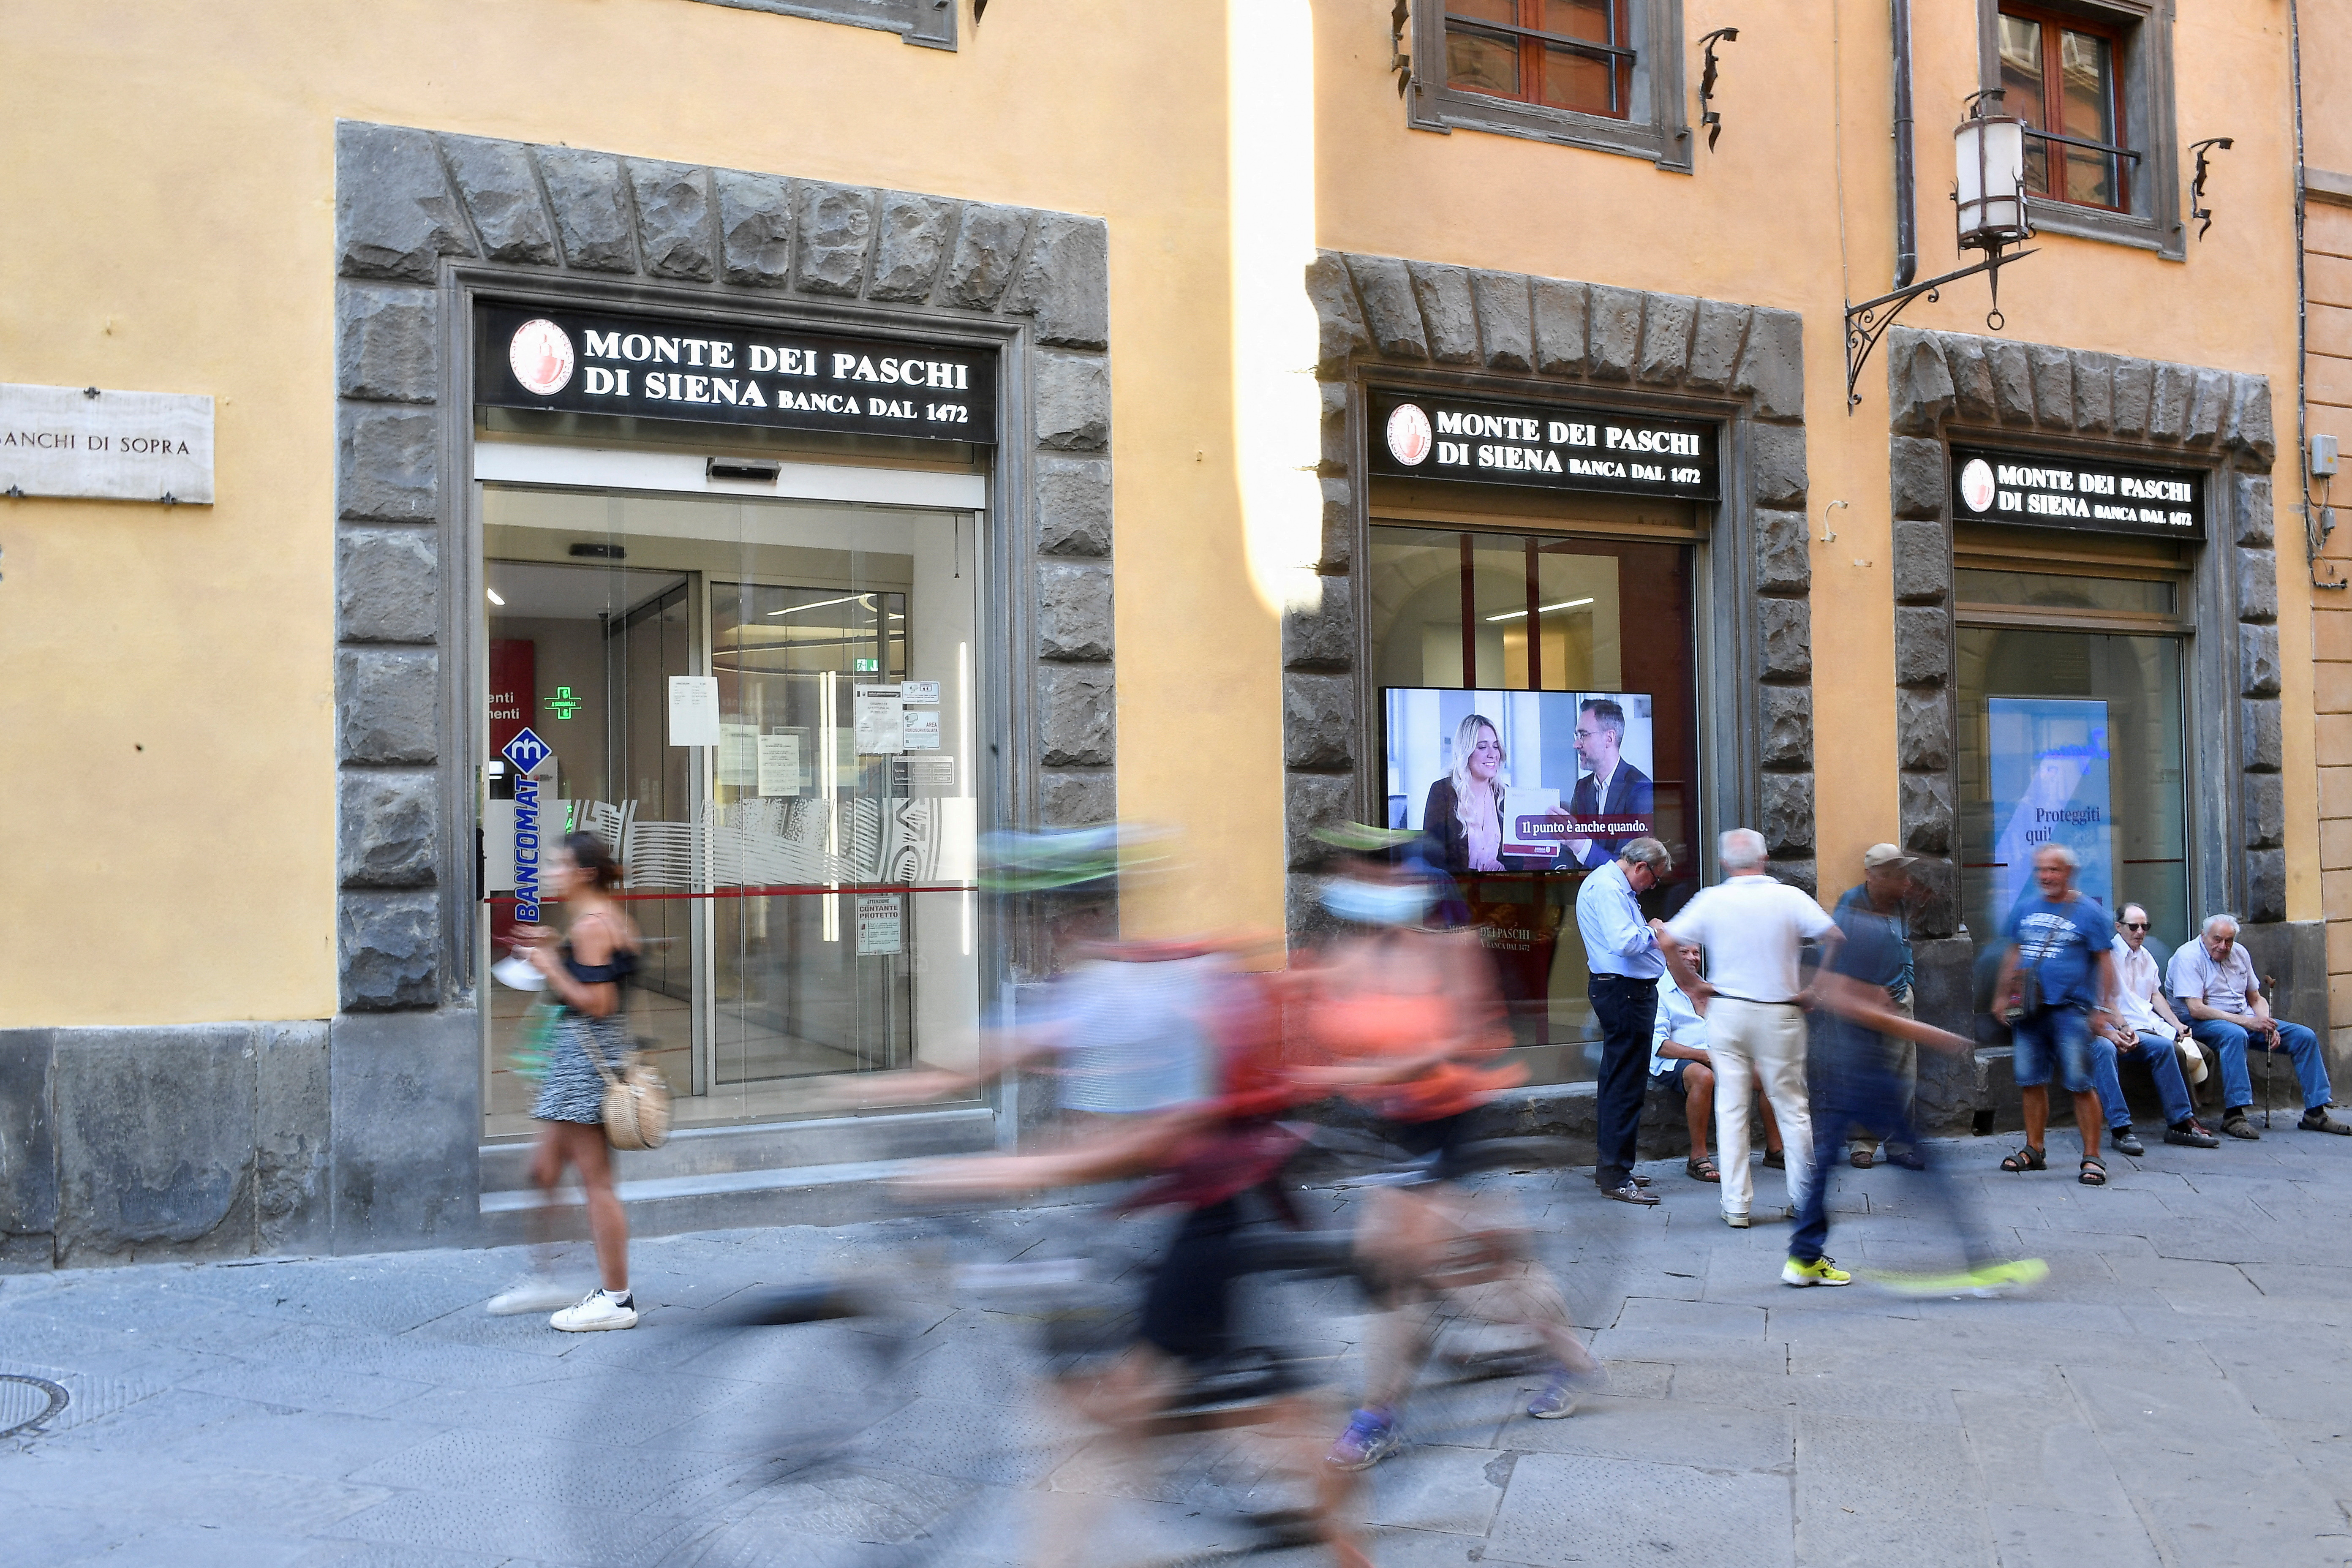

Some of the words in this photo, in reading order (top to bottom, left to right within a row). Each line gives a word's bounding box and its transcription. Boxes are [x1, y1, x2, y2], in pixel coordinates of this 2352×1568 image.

[584, 330, 734, 368] MONTE
[749, 346, 817, 376] DEI
[833, 354, 968, 389] PASCHI
[584, 367, 629, 396] DI
[645, 373, 767, 407] SIENA
[778, 391, 860, 414] BANCA
[869, 398, 917, 418] DAL
[926, 403, 968, 422] 1472
[0, 432, 75, 449] ANCHI
[88, 435, 109, 451] DI
[120, 437, 190, 455] SOPRA
[1437, 411, 1540, 441] MONTE
[1549, 422, 1596, 446] DEI
[1605, 427, 1699, 455] PASCHI
[1437, 442, 1469, 465] DI
[1479, 445, 1563, 472] SIENA
[1569, 459, 1626, 477] BANCA
[1631, 464, 1665, 480] DAL
[1671, 468, 1700, 483] 1472
[1998, 465, 2073, 491] MONTE
[2079, 474, 2114, 495] DEI
[2121, 477, 2191, 502] PASCHI
[1998, 492, 2022, 512] DI
[2028, 494, 2090, 518] SIENA
[2094, 505, 2137, 521] BANCA
[2140, 509, 2166, 524] DAL
[2170, 512, 2191, 526] 1472
[1522, 821, 1530, 833] Il
[1533, 822, 1564, 836] punto
[1567, 820, 1573, 832] è
[1575, 821, 1605, 832] anche
[1608, 820, 1648, 835] quando.
[2036, 806, 2100, 825] Proteggiti
[514, 774, 540, 922] BANCOMAT
[2026, 826, 2052, 845] qui!
[1481, 927, 1495, 937] DEI
[1498, 928, 1530, 939] PASCHI
